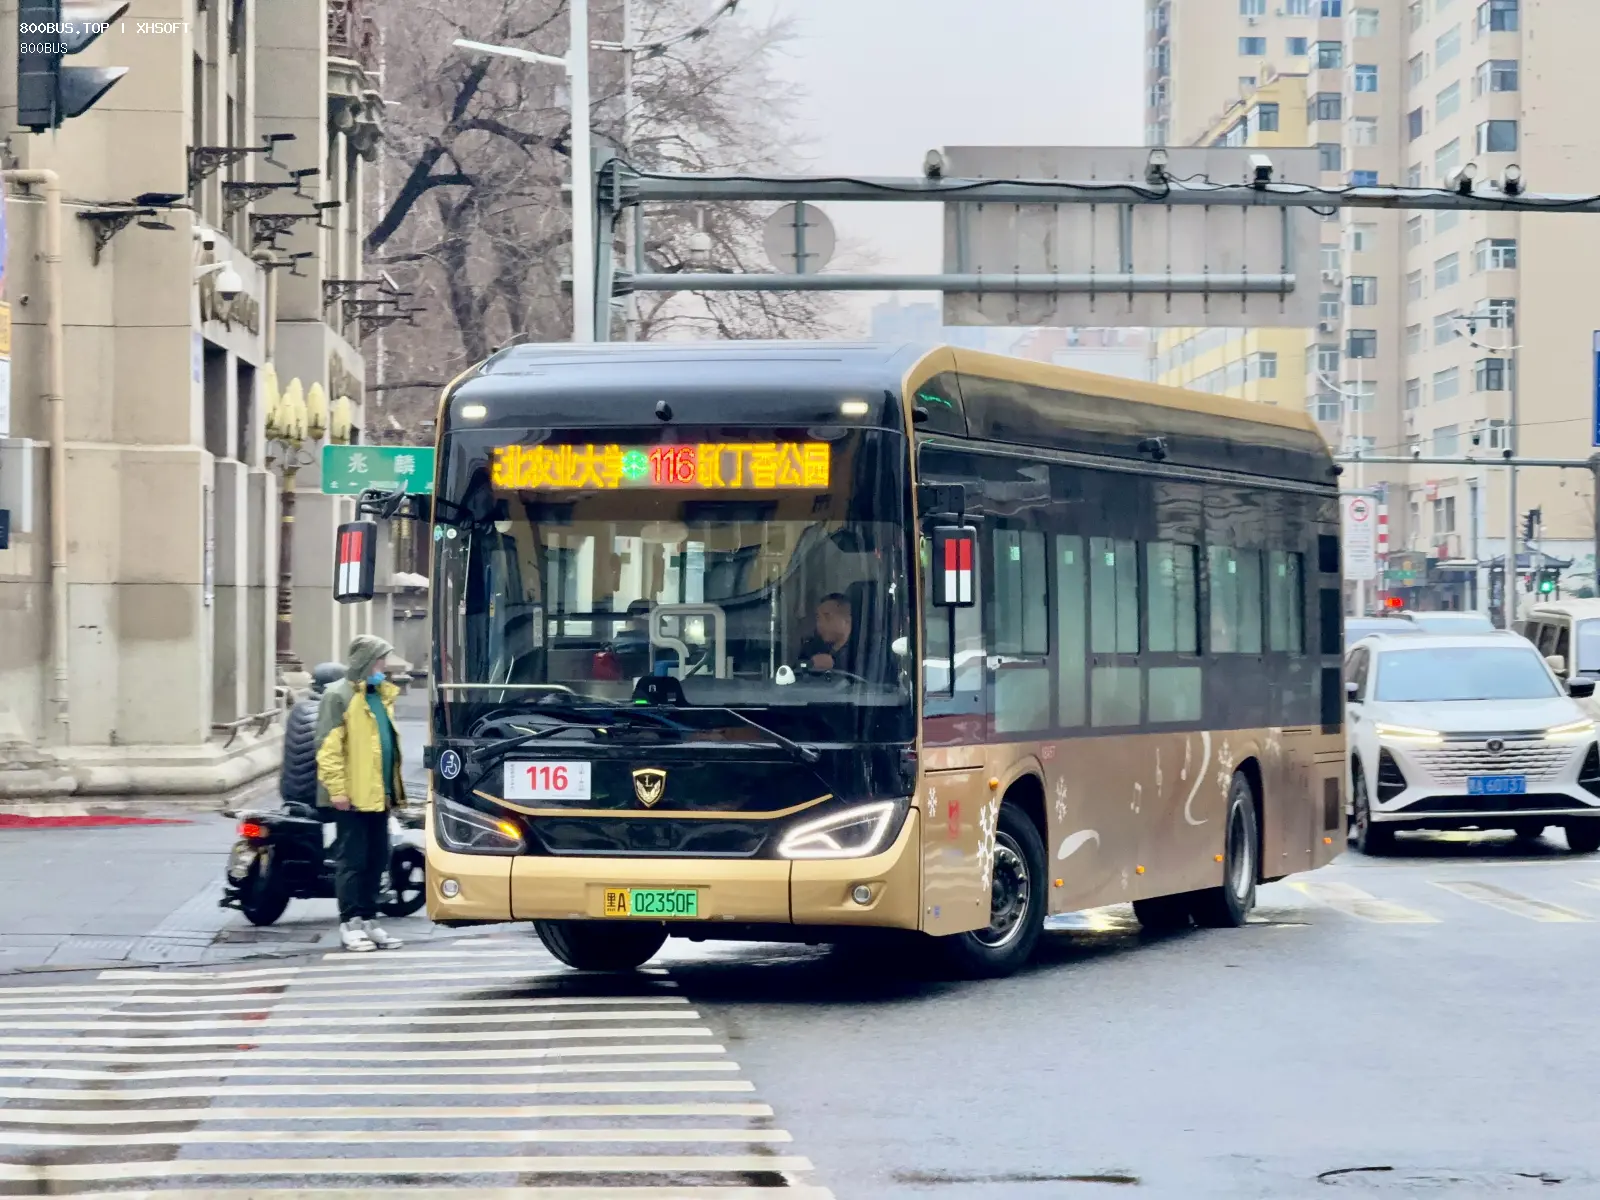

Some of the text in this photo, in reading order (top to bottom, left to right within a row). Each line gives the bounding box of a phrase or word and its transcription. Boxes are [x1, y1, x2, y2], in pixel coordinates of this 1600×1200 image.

[649, 447, 696, 484] 116
[526, 765, 569, 791] 116
[635, 892, 696, 913] 02350F
